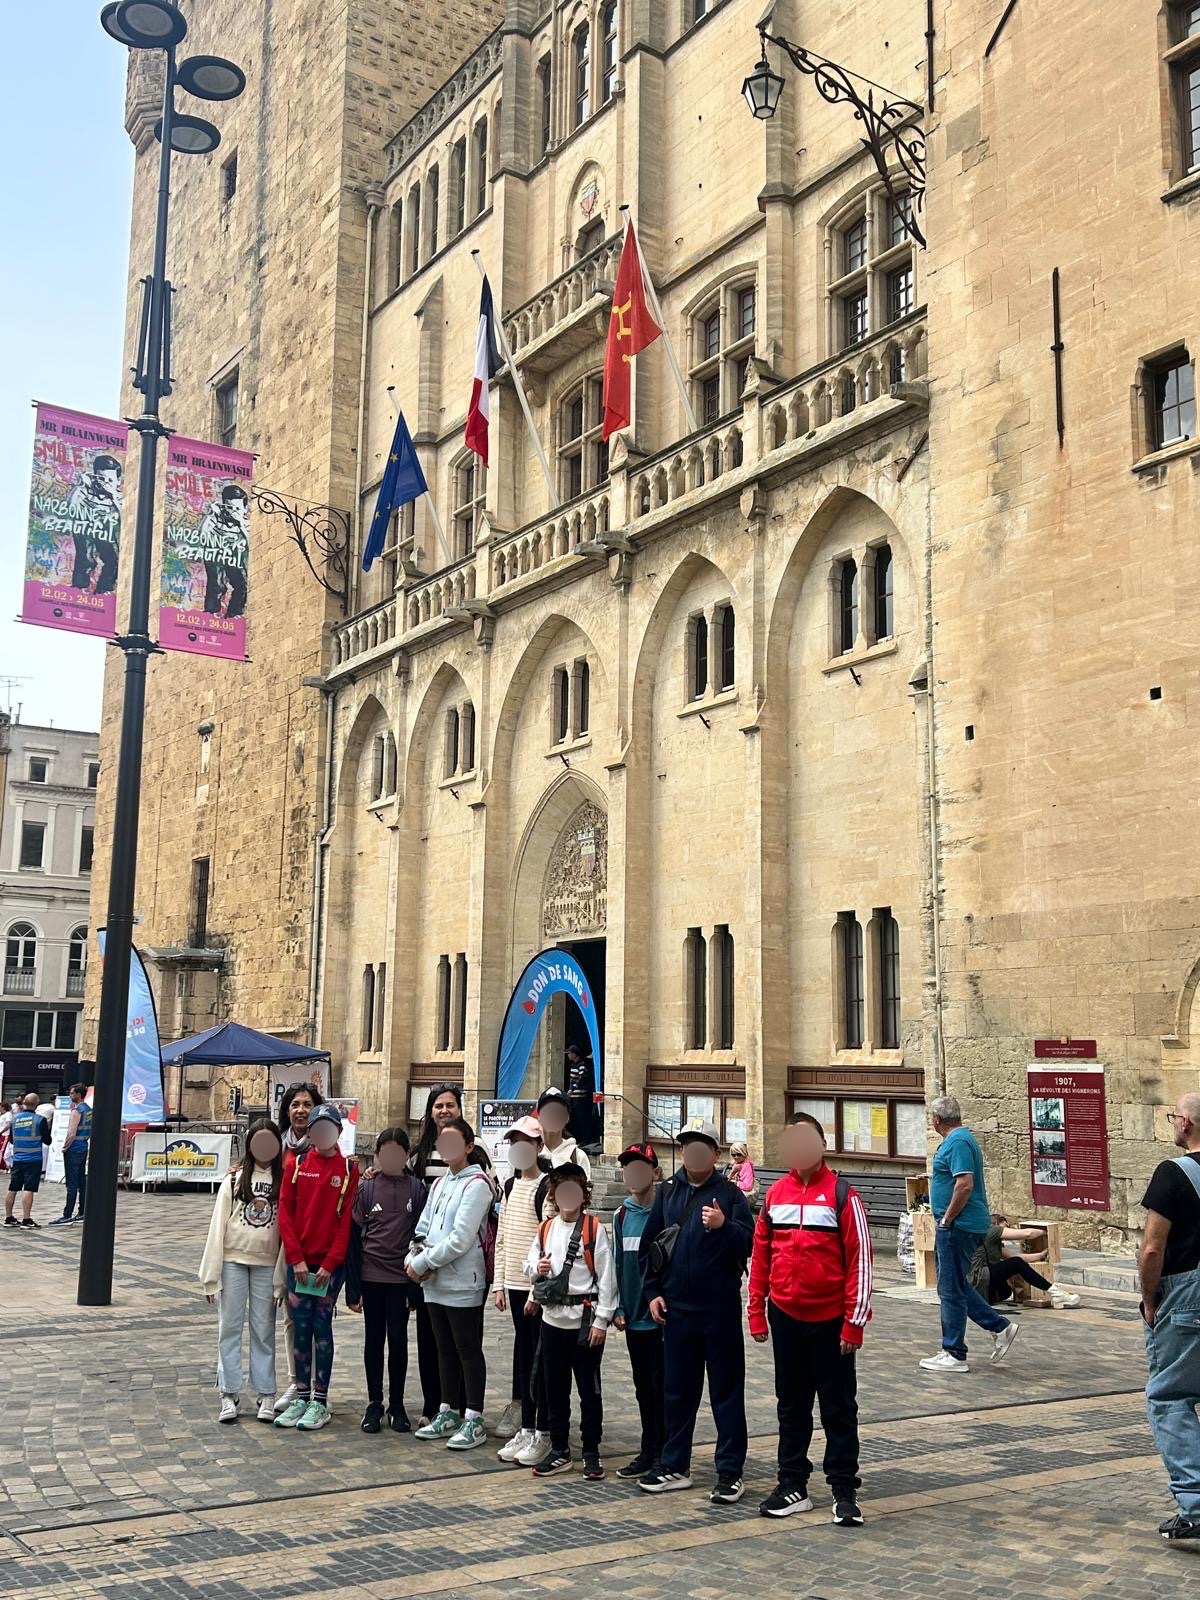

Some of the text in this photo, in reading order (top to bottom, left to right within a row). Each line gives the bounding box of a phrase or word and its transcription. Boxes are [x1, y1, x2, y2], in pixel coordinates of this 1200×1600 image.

[40, 420, 57, 433] MR
[61, 425, 125, 448] BRAINWASH
[34, 440, 84, 468] SMILE
[172, 453, 187, 464] MR
[192, 457, 250, 477] BRAINWASH
[166, 472, 213, 497] SMILE
[34, 496, 101, 521] NARBONNE
[167, 526, 230, 549] NARBONNE
[41, 587, 67, 601] 12.02
[76, 594, 104, 607] 24.05
[176, 613, 234, 631] 12.02 24.05
[528, 964, 583, 1003] DON DE SANG
[1054, 1077, 1076, 1087] 1907,
[151, 1157, 185, 1166] GRAND
[186, 1158, 206, 1167] SUD
